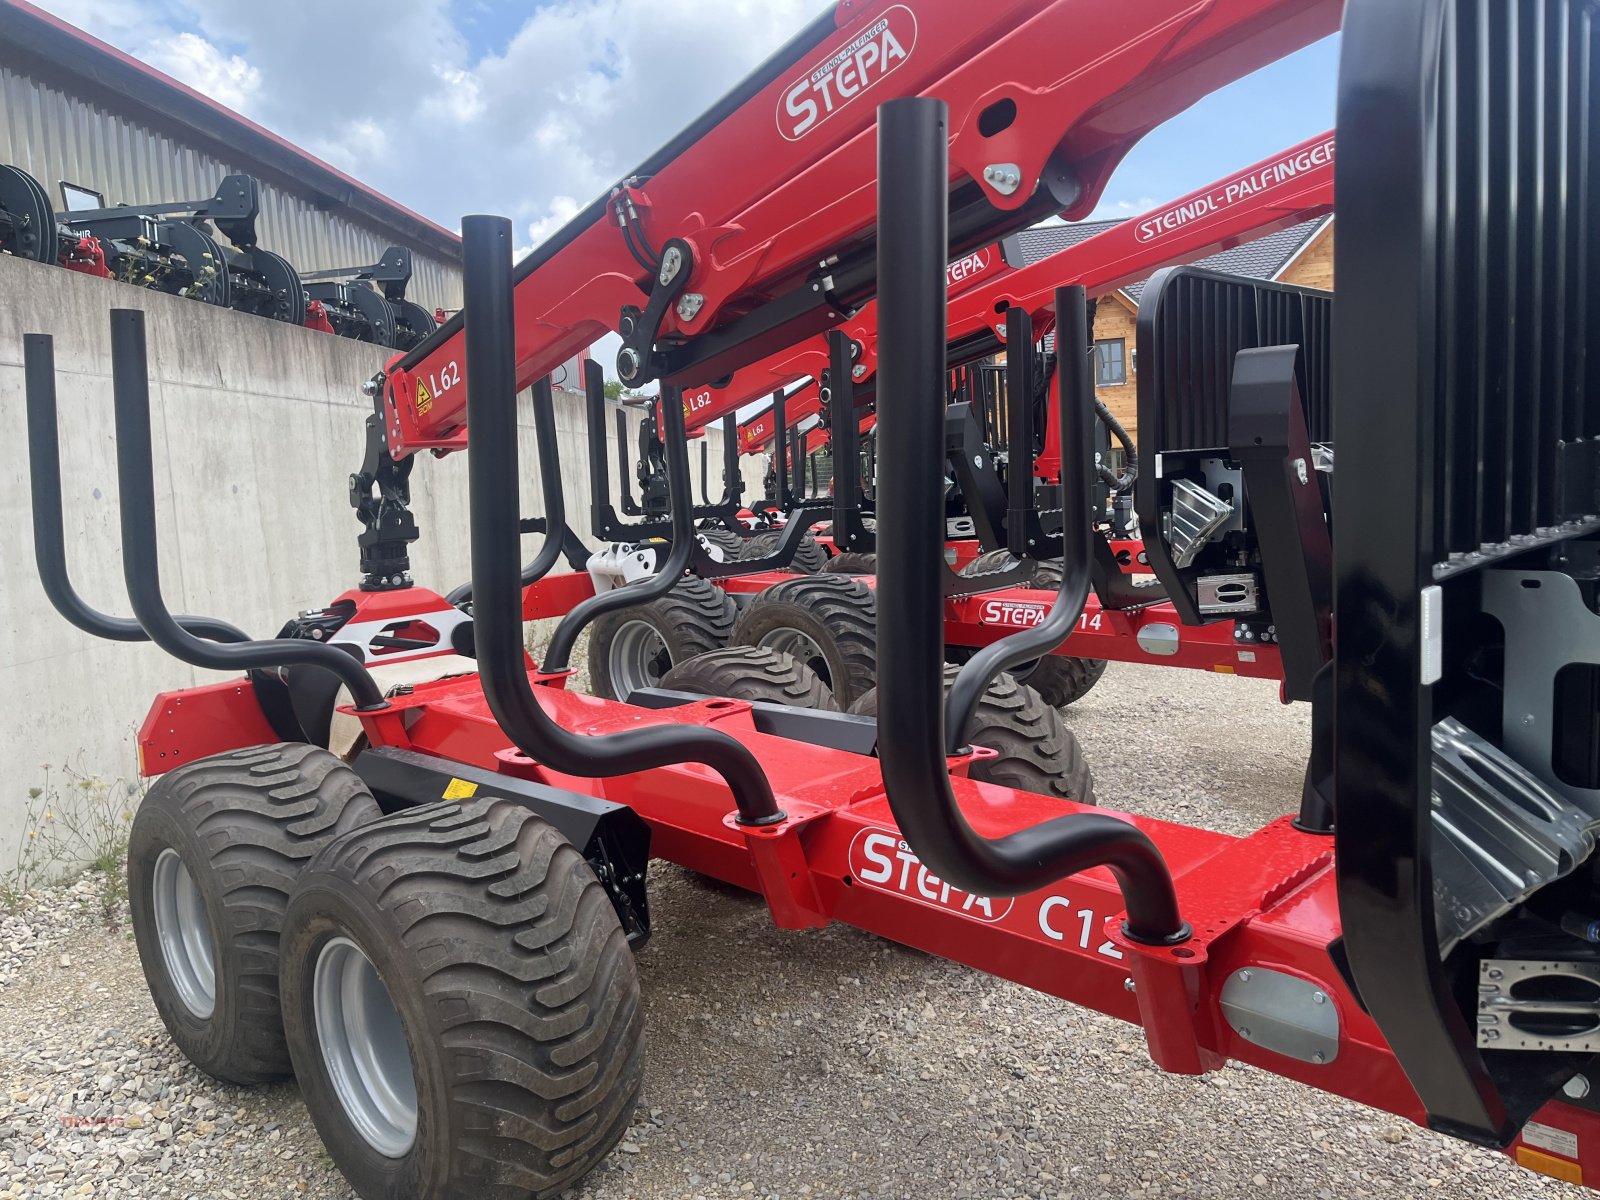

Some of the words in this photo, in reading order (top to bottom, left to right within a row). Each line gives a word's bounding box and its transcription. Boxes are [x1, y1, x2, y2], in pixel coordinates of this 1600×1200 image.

[812, 19, 888, 82] STEINDL-PALFINGER
[785, 28, 907, 137] STEPA
[429, 360, 461, 399] L62
[689, 391, 712, 412] L82
[752, 423, 764, 437] L62
